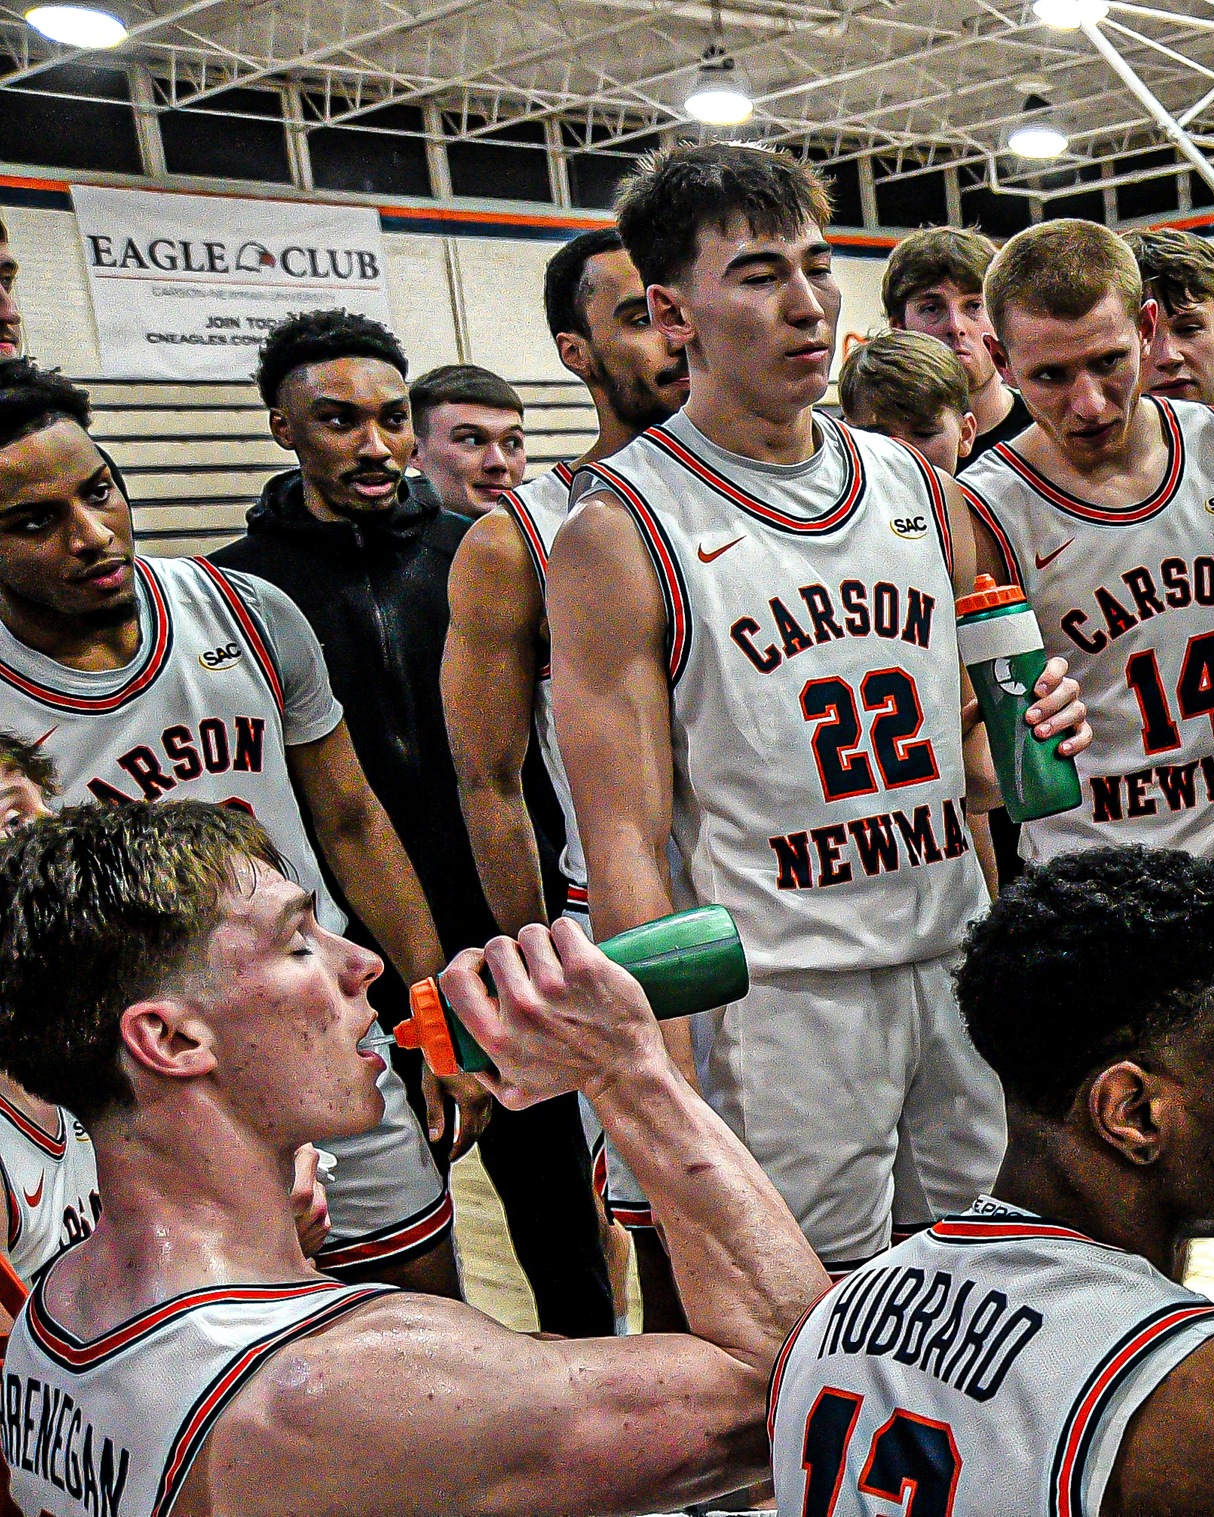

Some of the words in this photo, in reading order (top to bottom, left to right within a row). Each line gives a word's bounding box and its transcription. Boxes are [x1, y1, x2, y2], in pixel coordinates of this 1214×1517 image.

[87, 235, 229, 274] EAGLE
[280, 245, 380, 280] CLUB
[206, 315, 240, 329] JOIN
[894, 516, 928, 533] SAC
[729, 579, 936, 675] CARSON
[203, 642, 242, 666] SAC
[799, 666, 941, 803] 22
[816, 1265, 1044, 1403] HUBBARD
